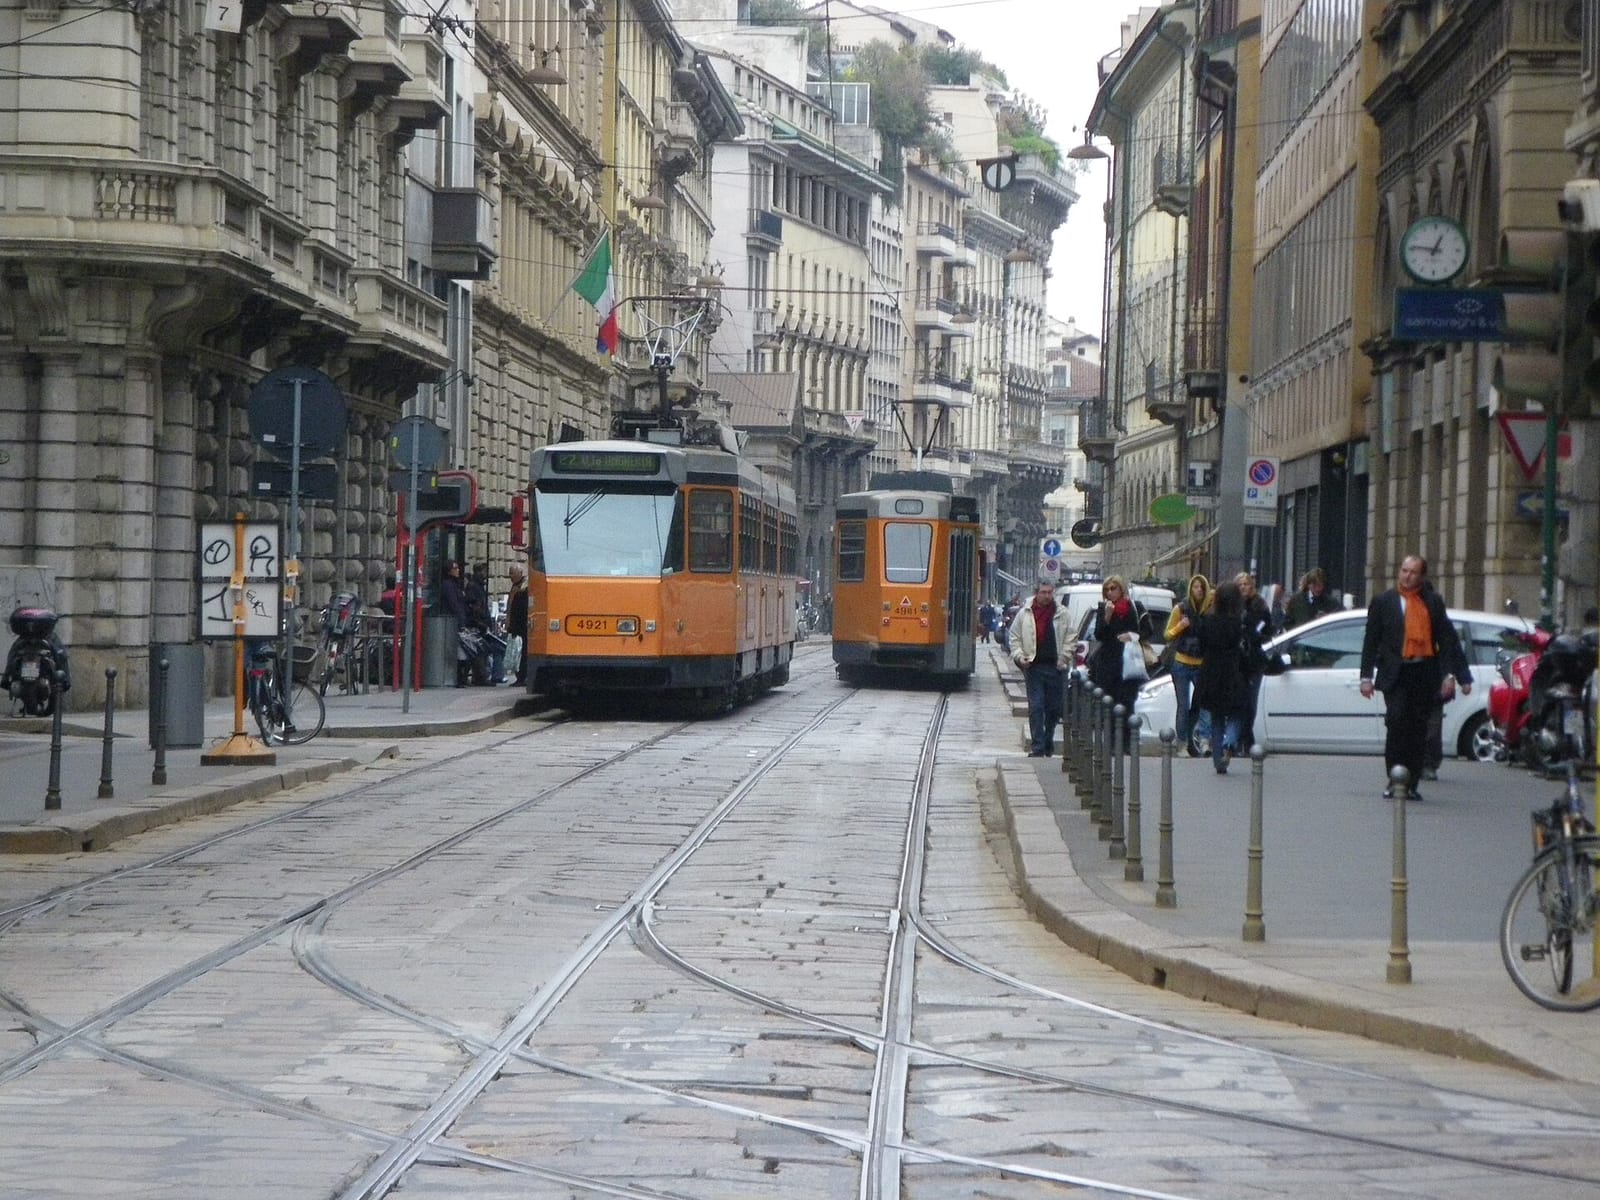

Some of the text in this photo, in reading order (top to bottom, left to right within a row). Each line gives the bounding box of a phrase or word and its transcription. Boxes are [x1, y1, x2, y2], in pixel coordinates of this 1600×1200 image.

[218, 5, 229, 21] 7
[1189, 462, 1212, 486] T
[577, 619, 607, 630] 4921
